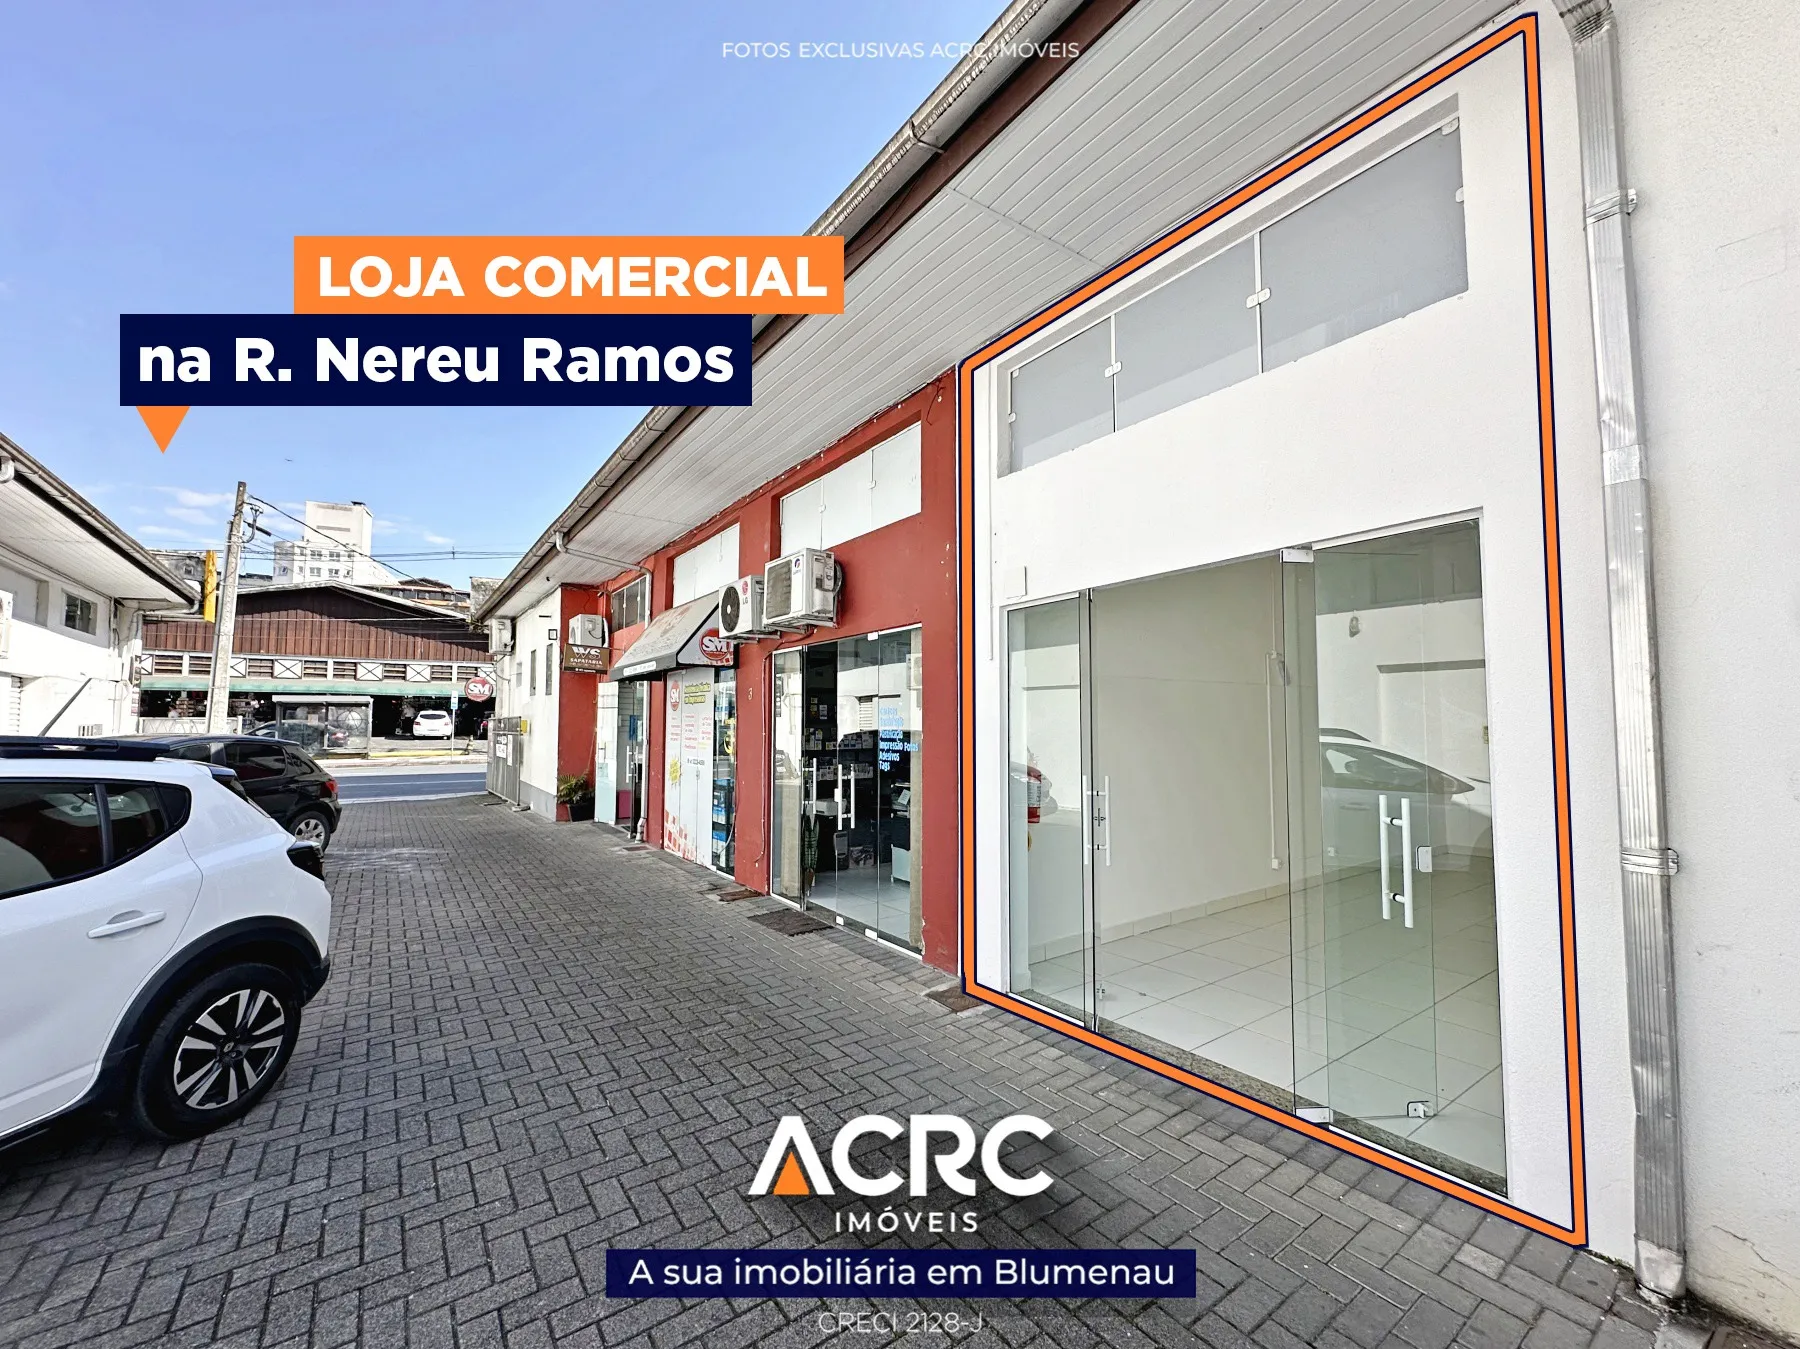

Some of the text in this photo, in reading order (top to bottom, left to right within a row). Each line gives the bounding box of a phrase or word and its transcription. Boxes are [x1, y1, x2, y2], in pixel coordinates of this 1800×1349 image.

[572, 646, 601, 659] WS
[570, 657, 603, 665] SAPATARIA
[467, 682, 491, 695] SM
[879, 740, 904, 751] Impressão
[879, 750, 900, 762] Adesivos
[879, 761, 891, 771] Tags
